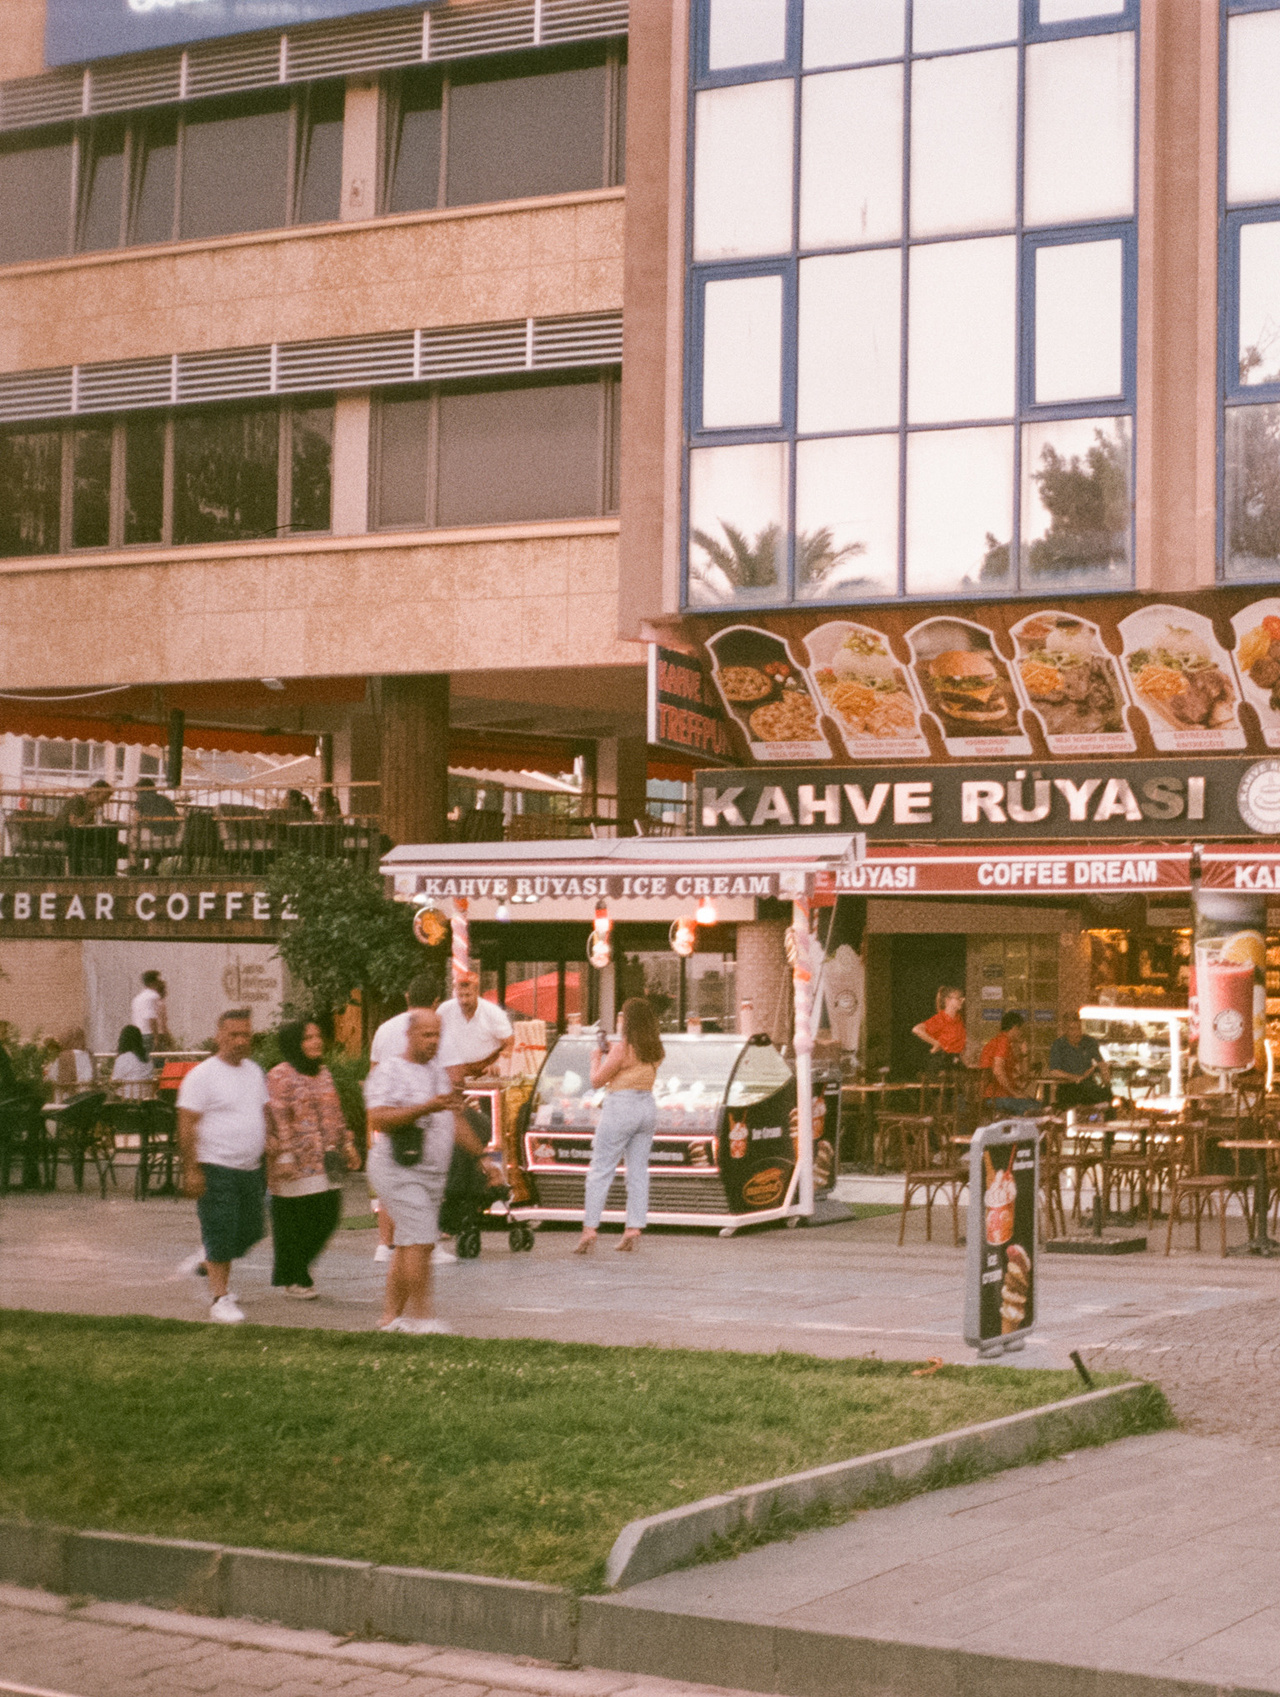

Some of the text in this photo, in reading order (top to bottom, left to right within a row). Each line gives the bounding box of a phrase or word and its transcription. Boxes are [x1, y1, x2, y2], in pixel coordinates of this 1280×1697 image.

[702, 782, 933, 827] KAHVE
[961, 769, 1206, 823] RÜYASI
[425, 876, 771, 896] KAHVE RÜYASI ICE CREAM
[977, 860, 1157, 886] COFFEE DREAM
